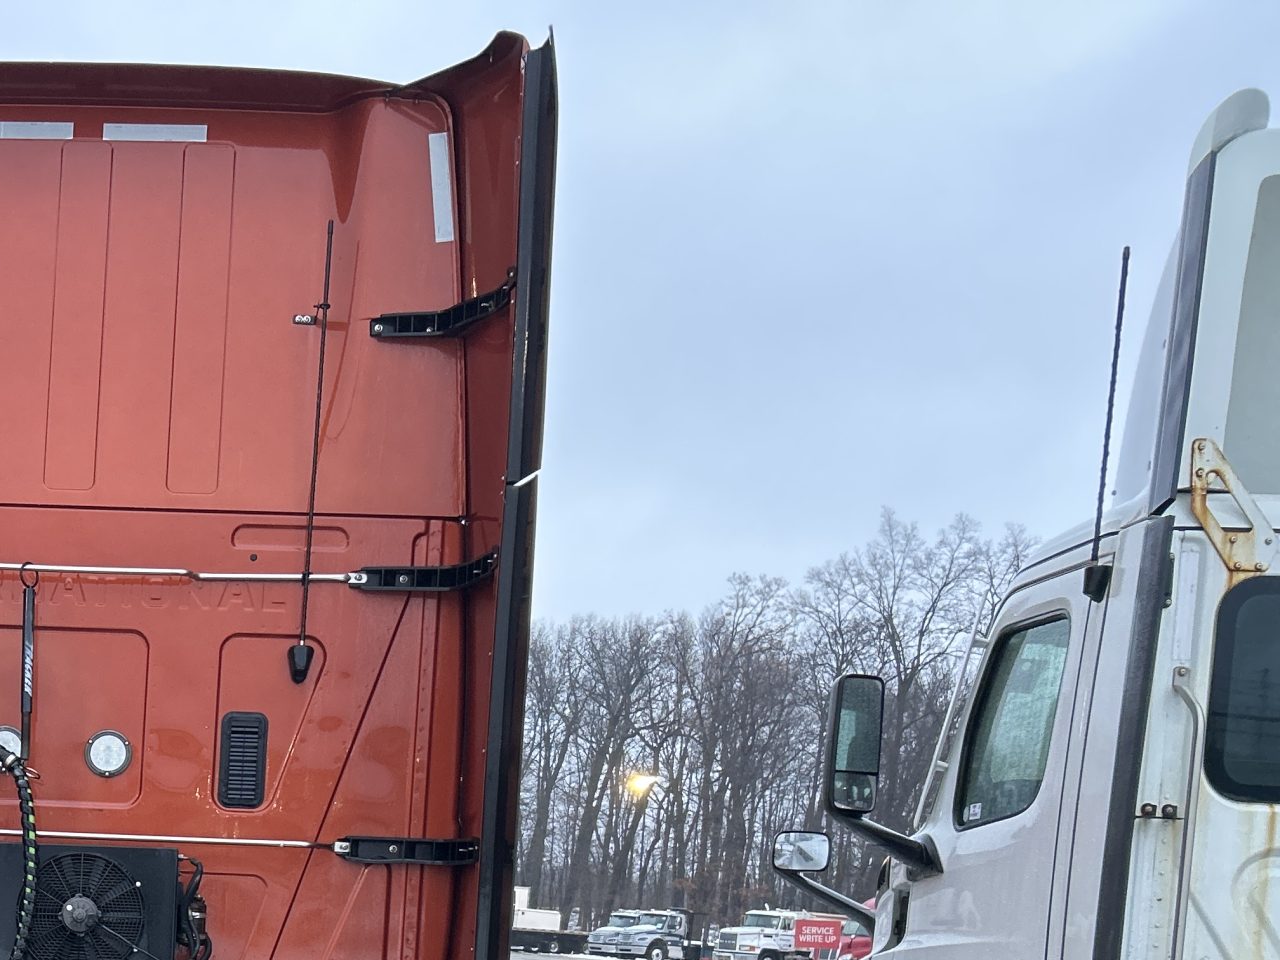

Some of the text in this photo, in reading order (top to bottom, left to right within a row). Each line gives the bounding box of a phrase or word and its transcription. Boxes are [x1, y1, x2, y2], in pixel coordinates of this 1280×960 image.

[801, 926, 835, 935] SERVICE
[798, 934, 824, 943] WRITE
[825, 935, 837, 944] UP
